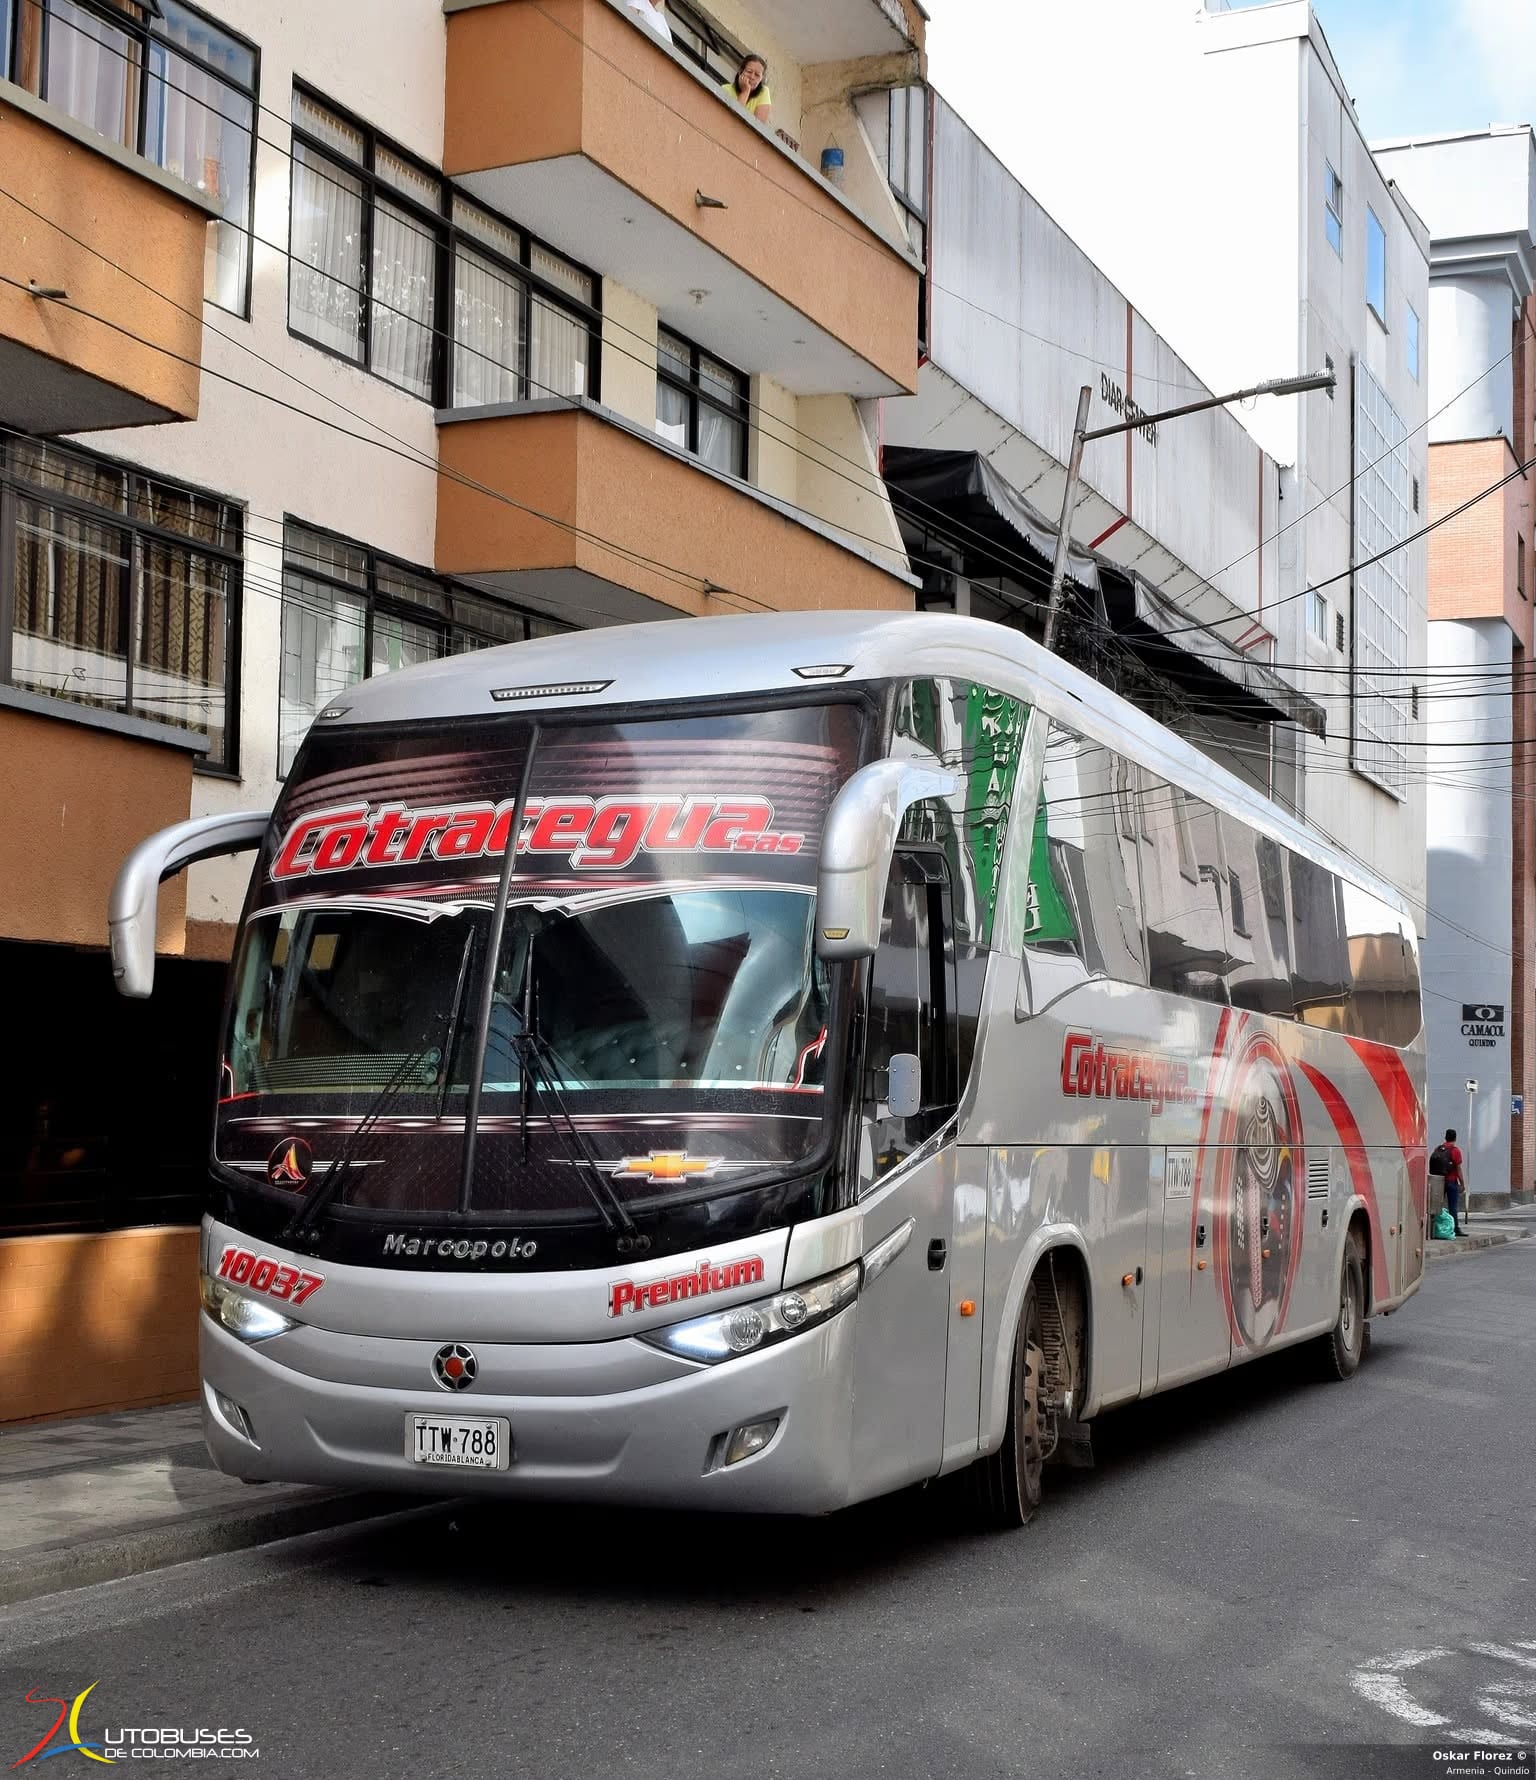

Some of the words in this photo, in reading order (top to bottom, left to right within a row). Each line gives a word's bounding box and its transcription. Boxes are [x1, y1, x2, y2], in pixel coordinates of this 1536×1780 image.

[270, 794, 775, 881] Cotracegua
[733, 831, 806, 855] sas
[1461, 1024, 1505, 1037] CAMACOL
[1061, 1024, 1189, 1117] Cotracegua
[216, 1243, 327, 1309] 10037
[382, 1233, 537, 1260] Marcopolo
[607, 1254, 765, 1318] Premium
[427, 1453, 484, 1465] FLORIDABLANCA
